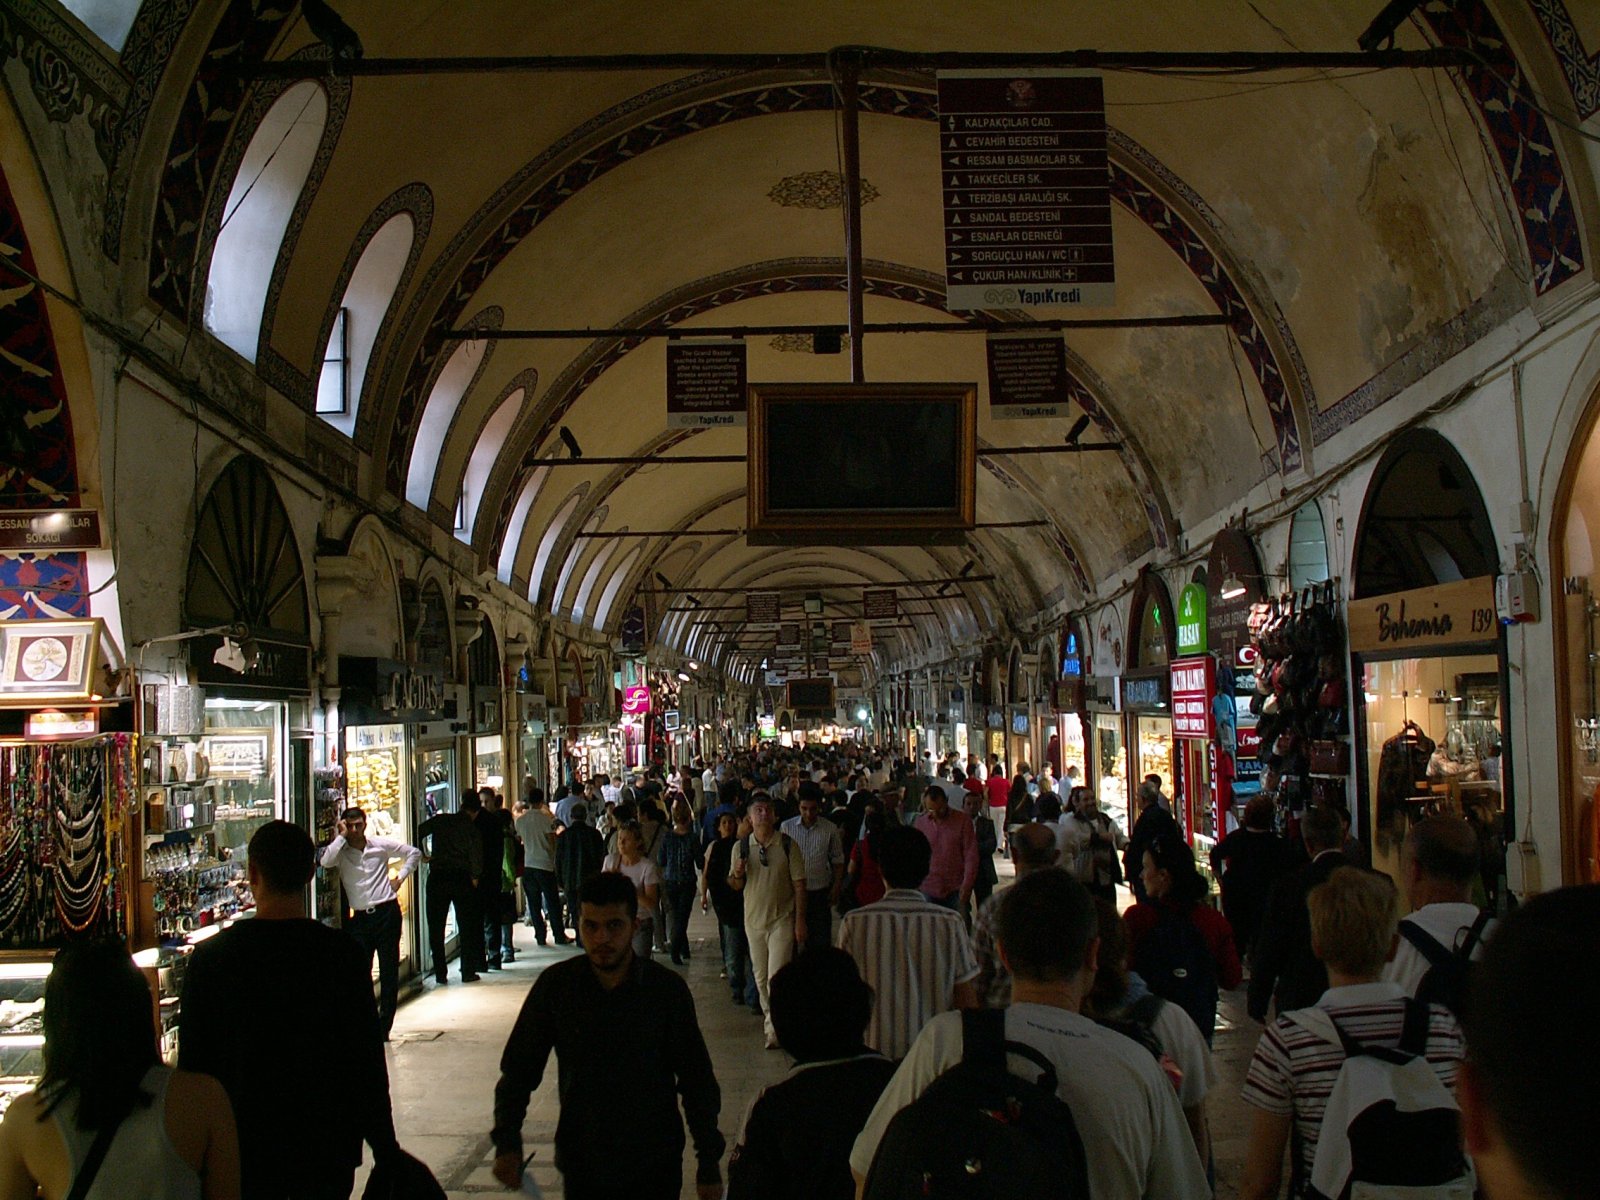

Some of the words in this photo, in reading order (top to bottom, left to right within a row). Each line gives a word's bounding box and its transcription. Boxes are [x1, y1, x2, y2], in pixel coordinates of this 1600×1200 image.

[965, 119, 1029, 129] KALPAKÇILAR
[1031, 118, 1053, 126] CAD.
[966, 135, 1006, 146] CEVAHİR
[1008, 136, 1059, 146] BEDESTENİ
[967, 156, 1005, 165] RESSAM
[1008, 155, 1066, 164] BASMACILAR
[1069, 155, 1084, 164] SK.
[968, 173, 1025, 184] TAKKECİLER
[1028, 174, 1042, 183] SK.
[968, 192, 1016, 204] TERZİBAŞI
[1018, 192, 1055, 202] ARALIĞI
[1057, 193, 1071, 202] SK.
[970, 213, 1007, 222] SANDAL
[1010, 211, 1060, 222] BEDESTENİ
[971, 232, 1019, 242] ESNAFLAR
[1022, 229, 1062, 240] DERNEĞİ
[972, 250, 1022, 262] SORGUÇLU
[1026, 251, 1044, 260] HAN
[1052, 250, 1066, 260] WC
[973, 271, 1005, 283] ÇUKUR
[1018, 288, 1080, 305] YapıKredi
[1376, 600, 1452, 642] Bohemia
[1471, 609, 1492, 633] 139
